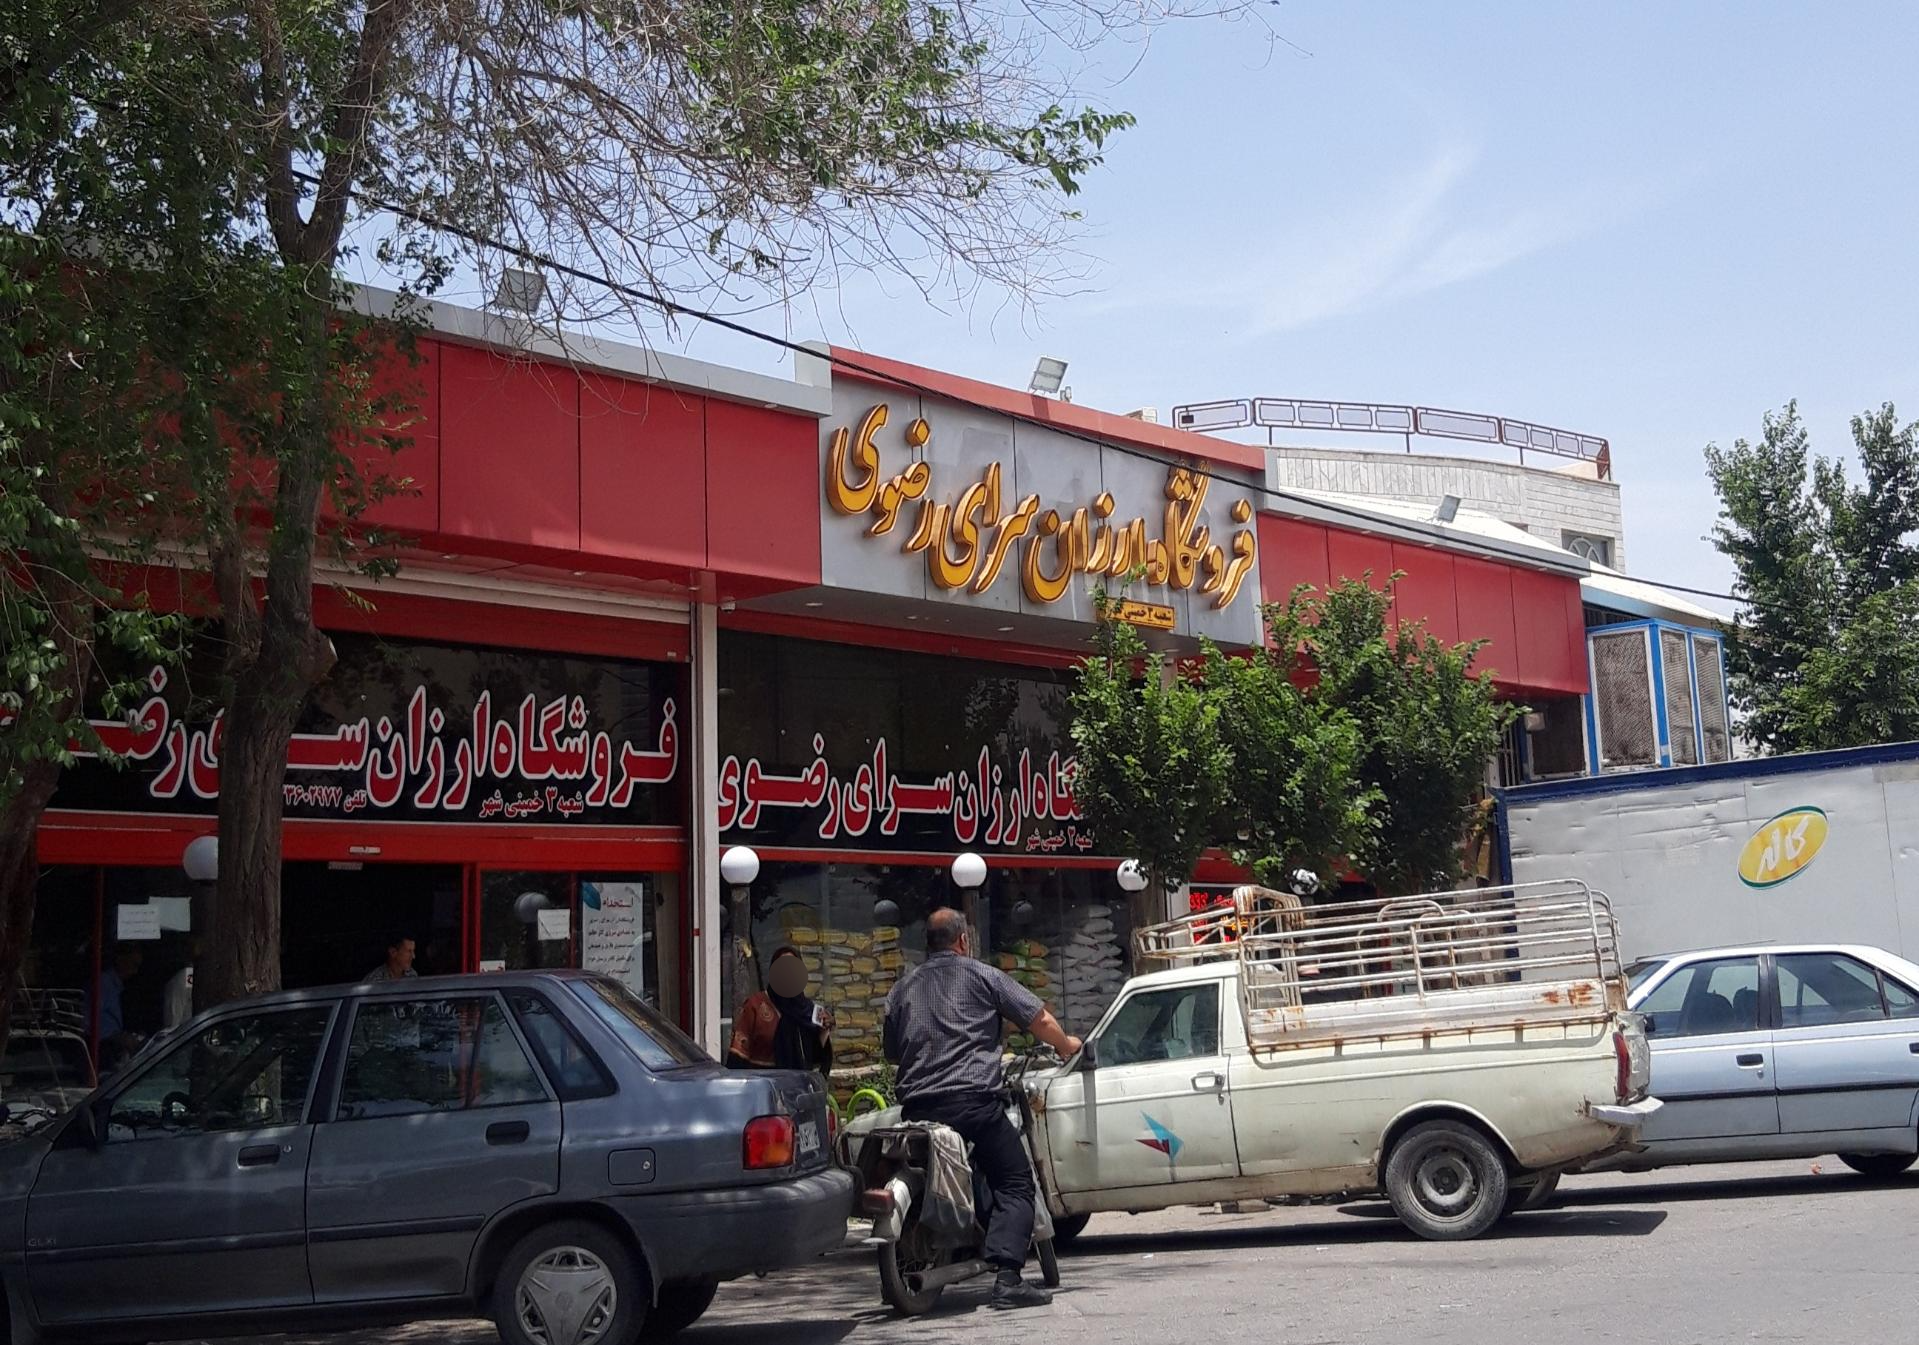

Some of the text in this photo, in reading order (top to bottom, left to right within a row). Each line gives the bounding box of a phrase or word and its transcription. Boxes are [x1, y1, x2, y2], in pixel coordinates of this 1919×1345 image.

[826, 402, 1257, 611] فروشگاه ارزان سرای رضوی
[366, 685, 490, 810] ارزان
[491, 693, 680, 808] فروشگاه
[718, 733, 841, 840] رضوی
[842, 738, 955, 837] سرای
[953, 745, 1030, 845] ارزان
[344, 789, 368, 813] تلفن
[479, 786, 584, 818] شعبه ۳ خمینی شهر
[602, 896, 634, 908] استخدام
